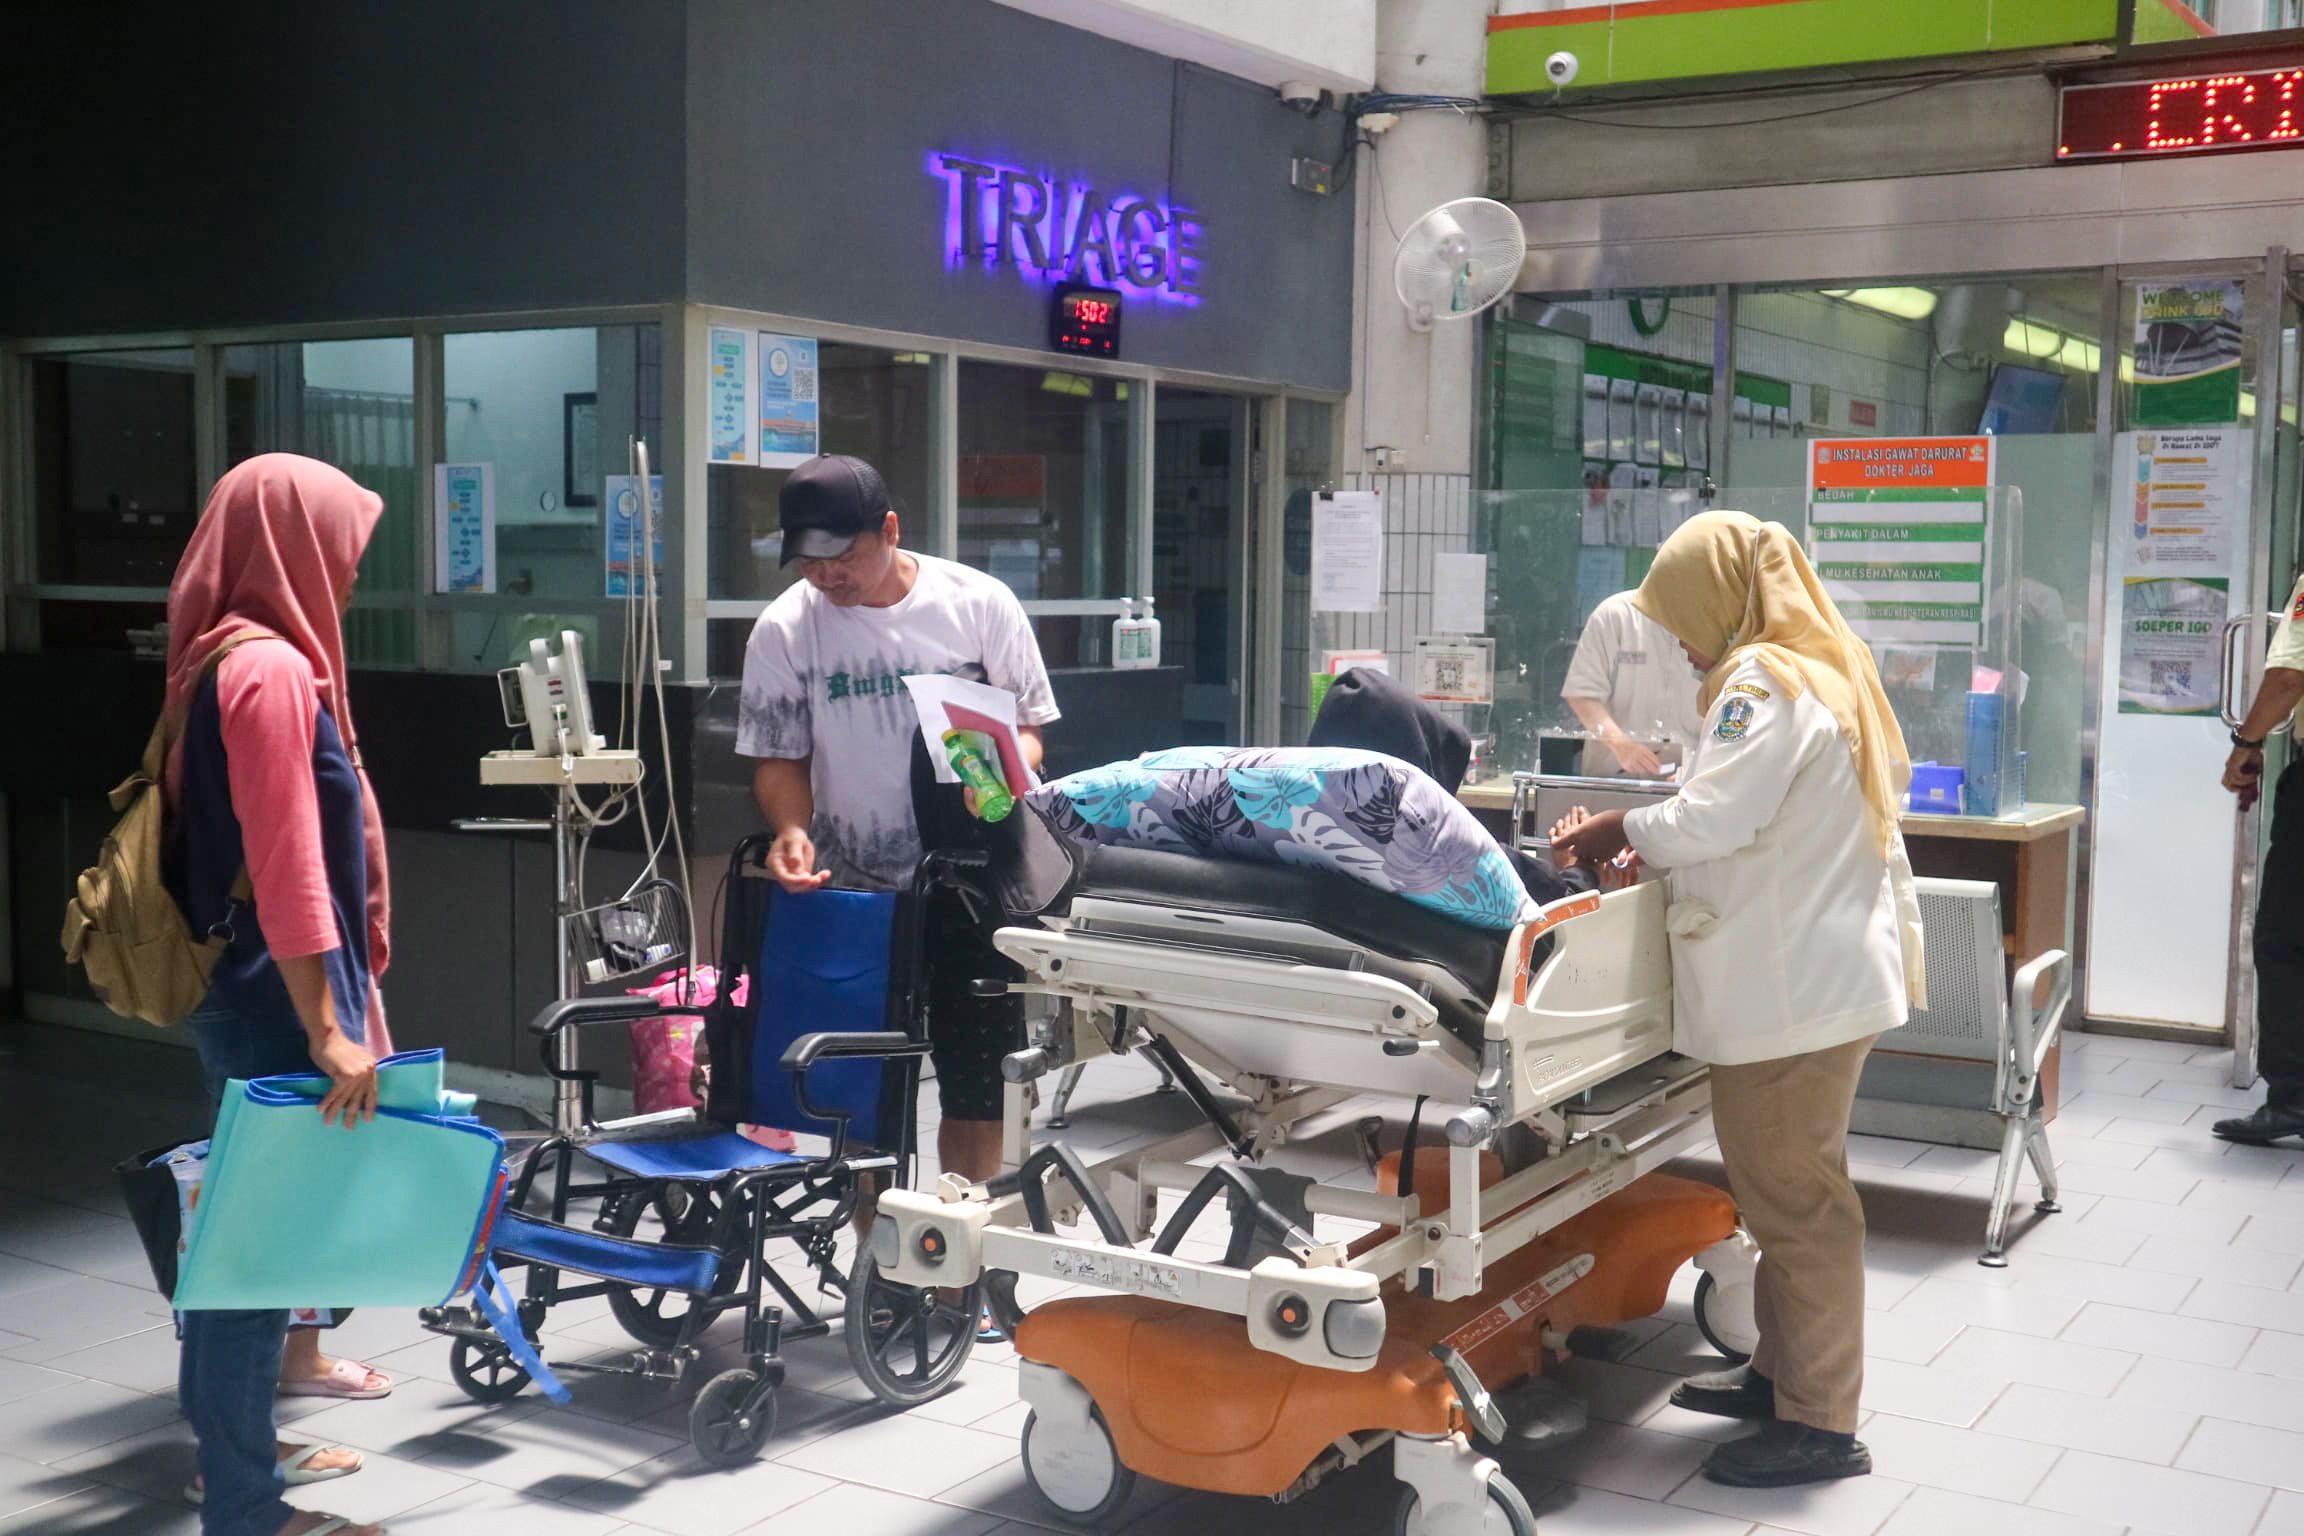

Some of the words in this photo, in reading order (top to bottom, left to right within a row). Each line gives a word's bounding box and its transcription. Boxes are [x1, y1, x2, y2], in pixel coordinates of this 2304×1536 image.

[937, 153, 1208, 298] TRIAGE
[1833, 448, 1882, 461] INSTALASI
[1885, 448, 1919, 461] GAWAT
[1922, 447, 1967, 460] DARURAT
[1864, 464, 1904, 477] DOKTER
[1908, 464, 1935, 477] JAGA
[1816, 528, 1868, 539] PENYAKIT
[1871, 528, 1909, 539] DALAM
[1844, 567, 1908, 579] KESEHATAN
[1911, 568, 1942, 580] ANAK
[2135, 620, 2184, 632] SOEPER
